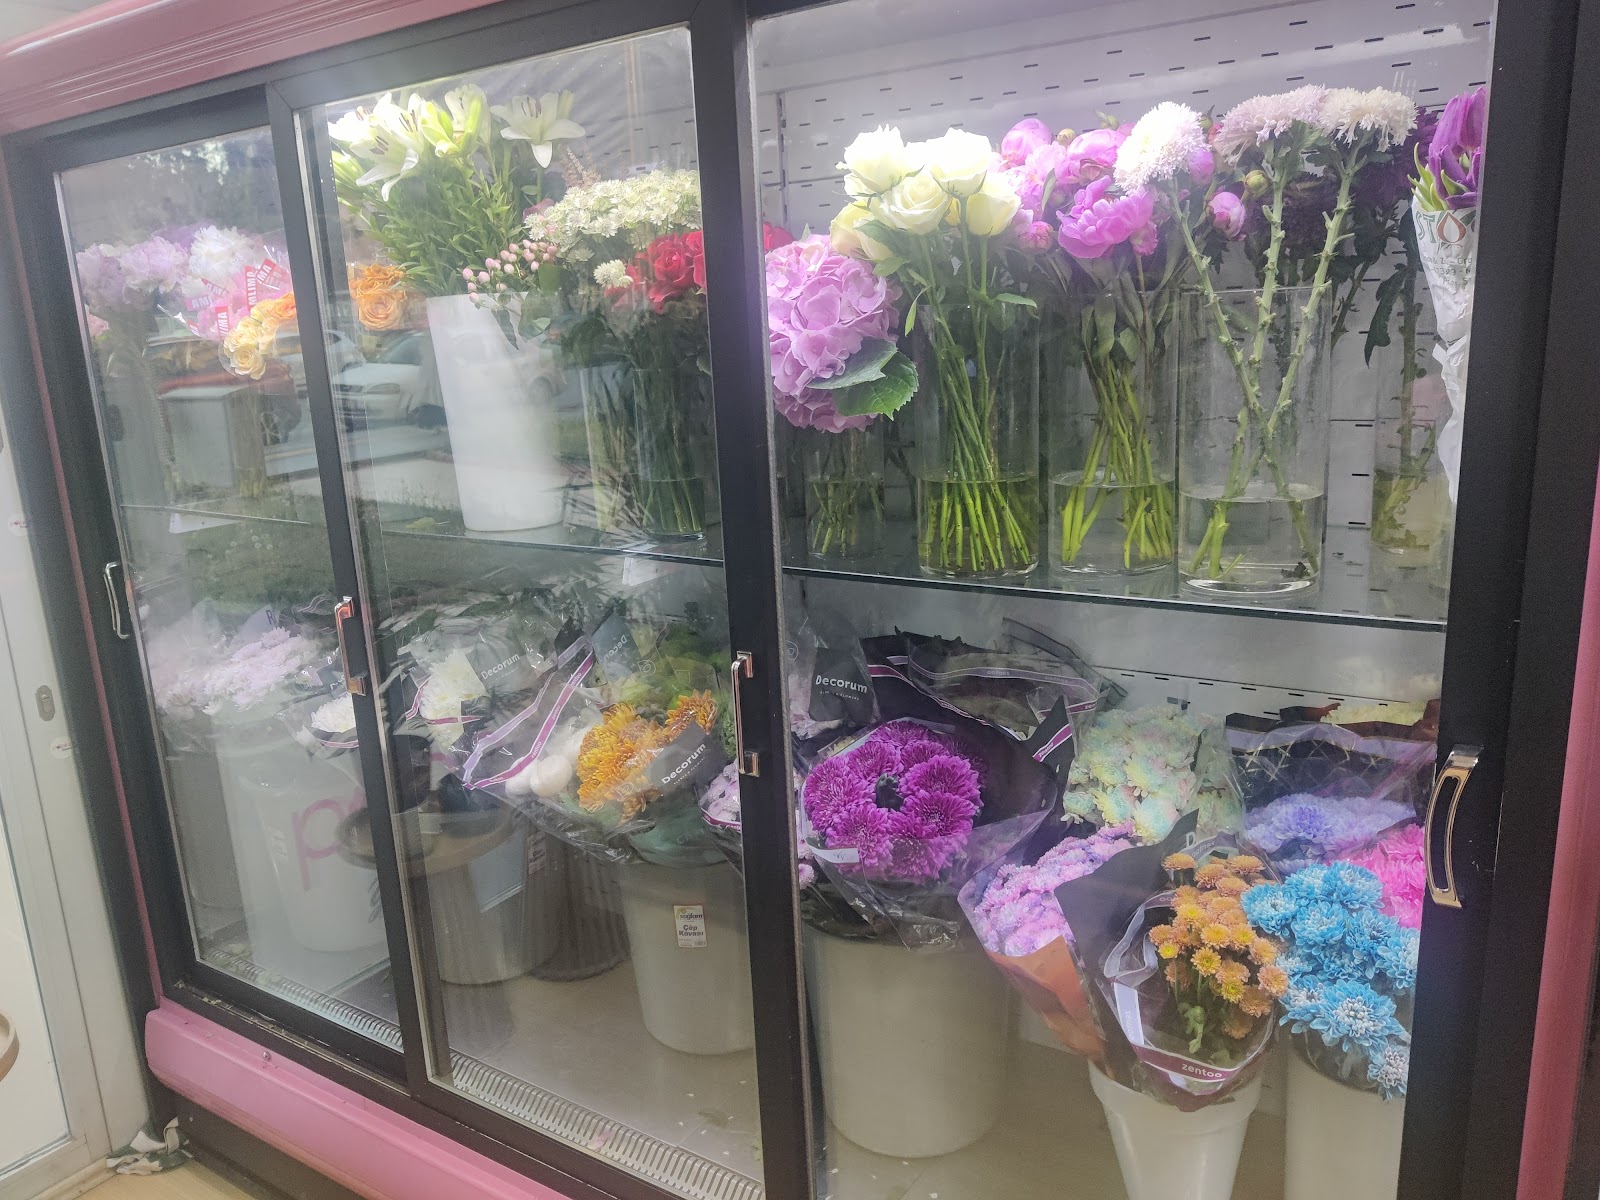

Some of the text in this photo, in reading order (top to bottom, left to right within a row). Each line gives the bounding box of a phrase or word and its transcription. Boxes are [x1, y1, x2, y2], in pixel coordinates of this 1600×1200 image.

[480, 653, 521, 681] Decorum
[815, 674, 868, 694] Decorum
[660, 743, 707, 785] Decorum
[1181, 1062, 1223, 1079] zentoo
